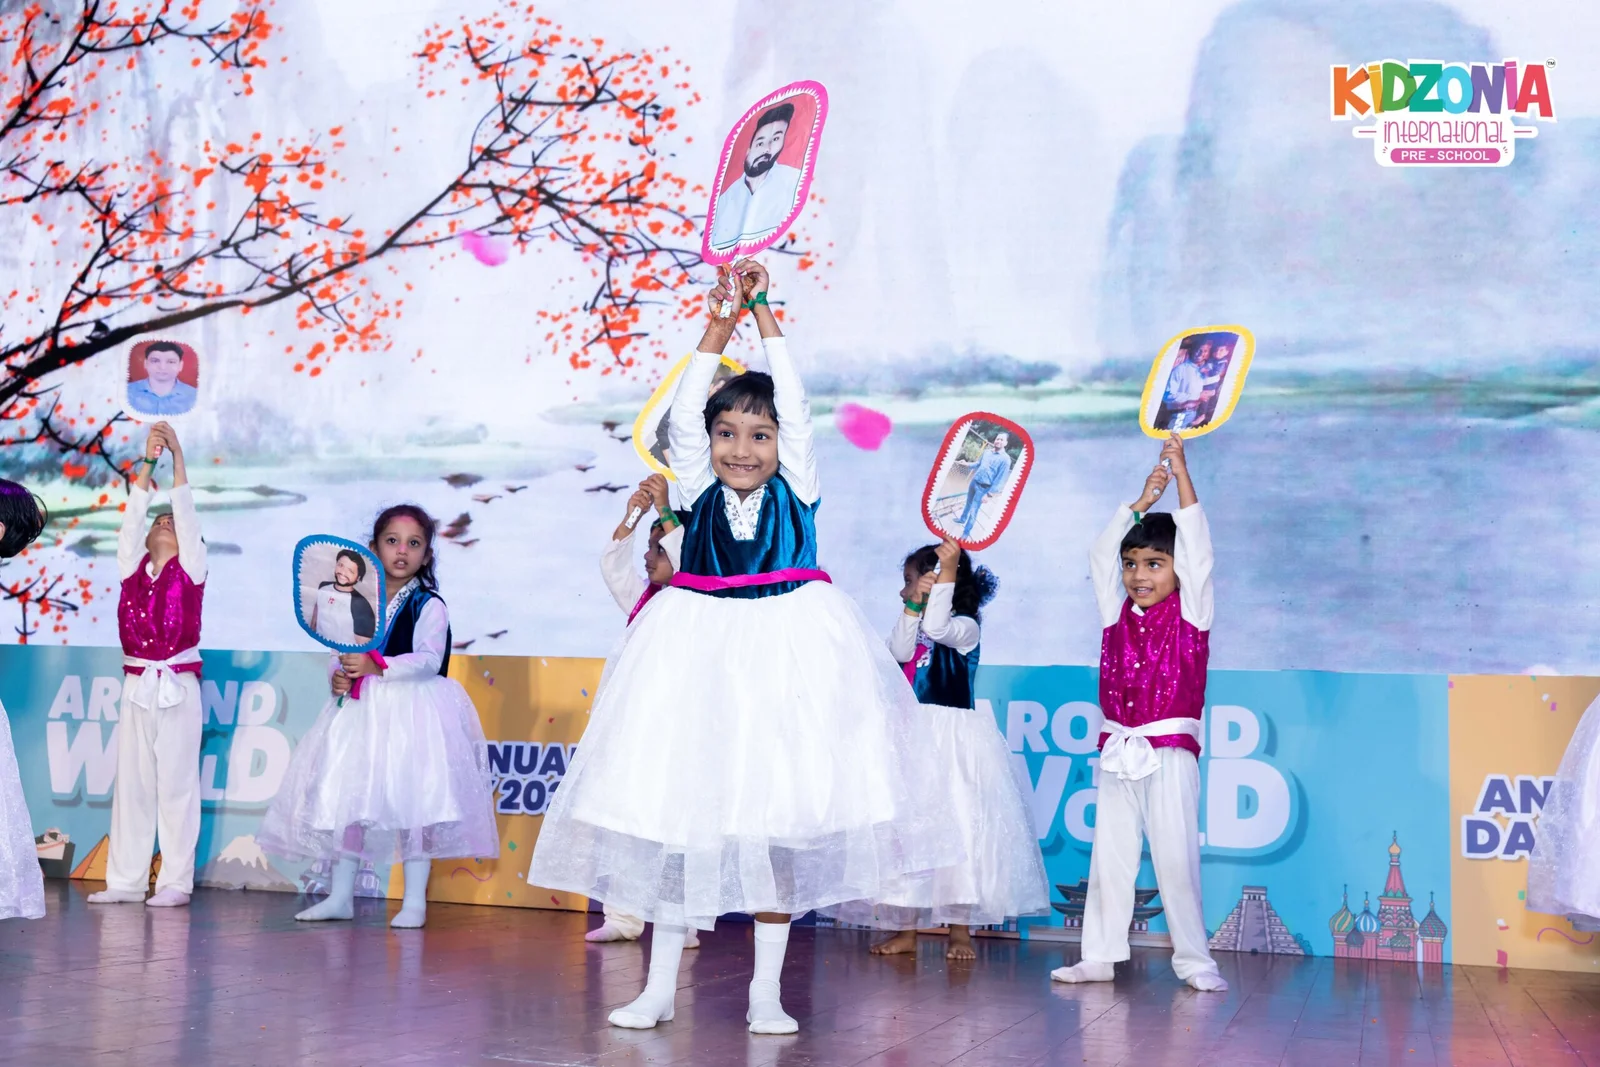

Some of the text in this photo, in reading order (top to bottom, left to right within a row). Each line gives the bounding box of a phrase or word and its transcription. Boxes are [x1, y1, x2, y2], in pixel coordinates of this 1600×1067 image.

[48, 675, 277, 725] ARND
[47, 721, 291, 802] WLD
[1466, 819, 1536, 855] DA
